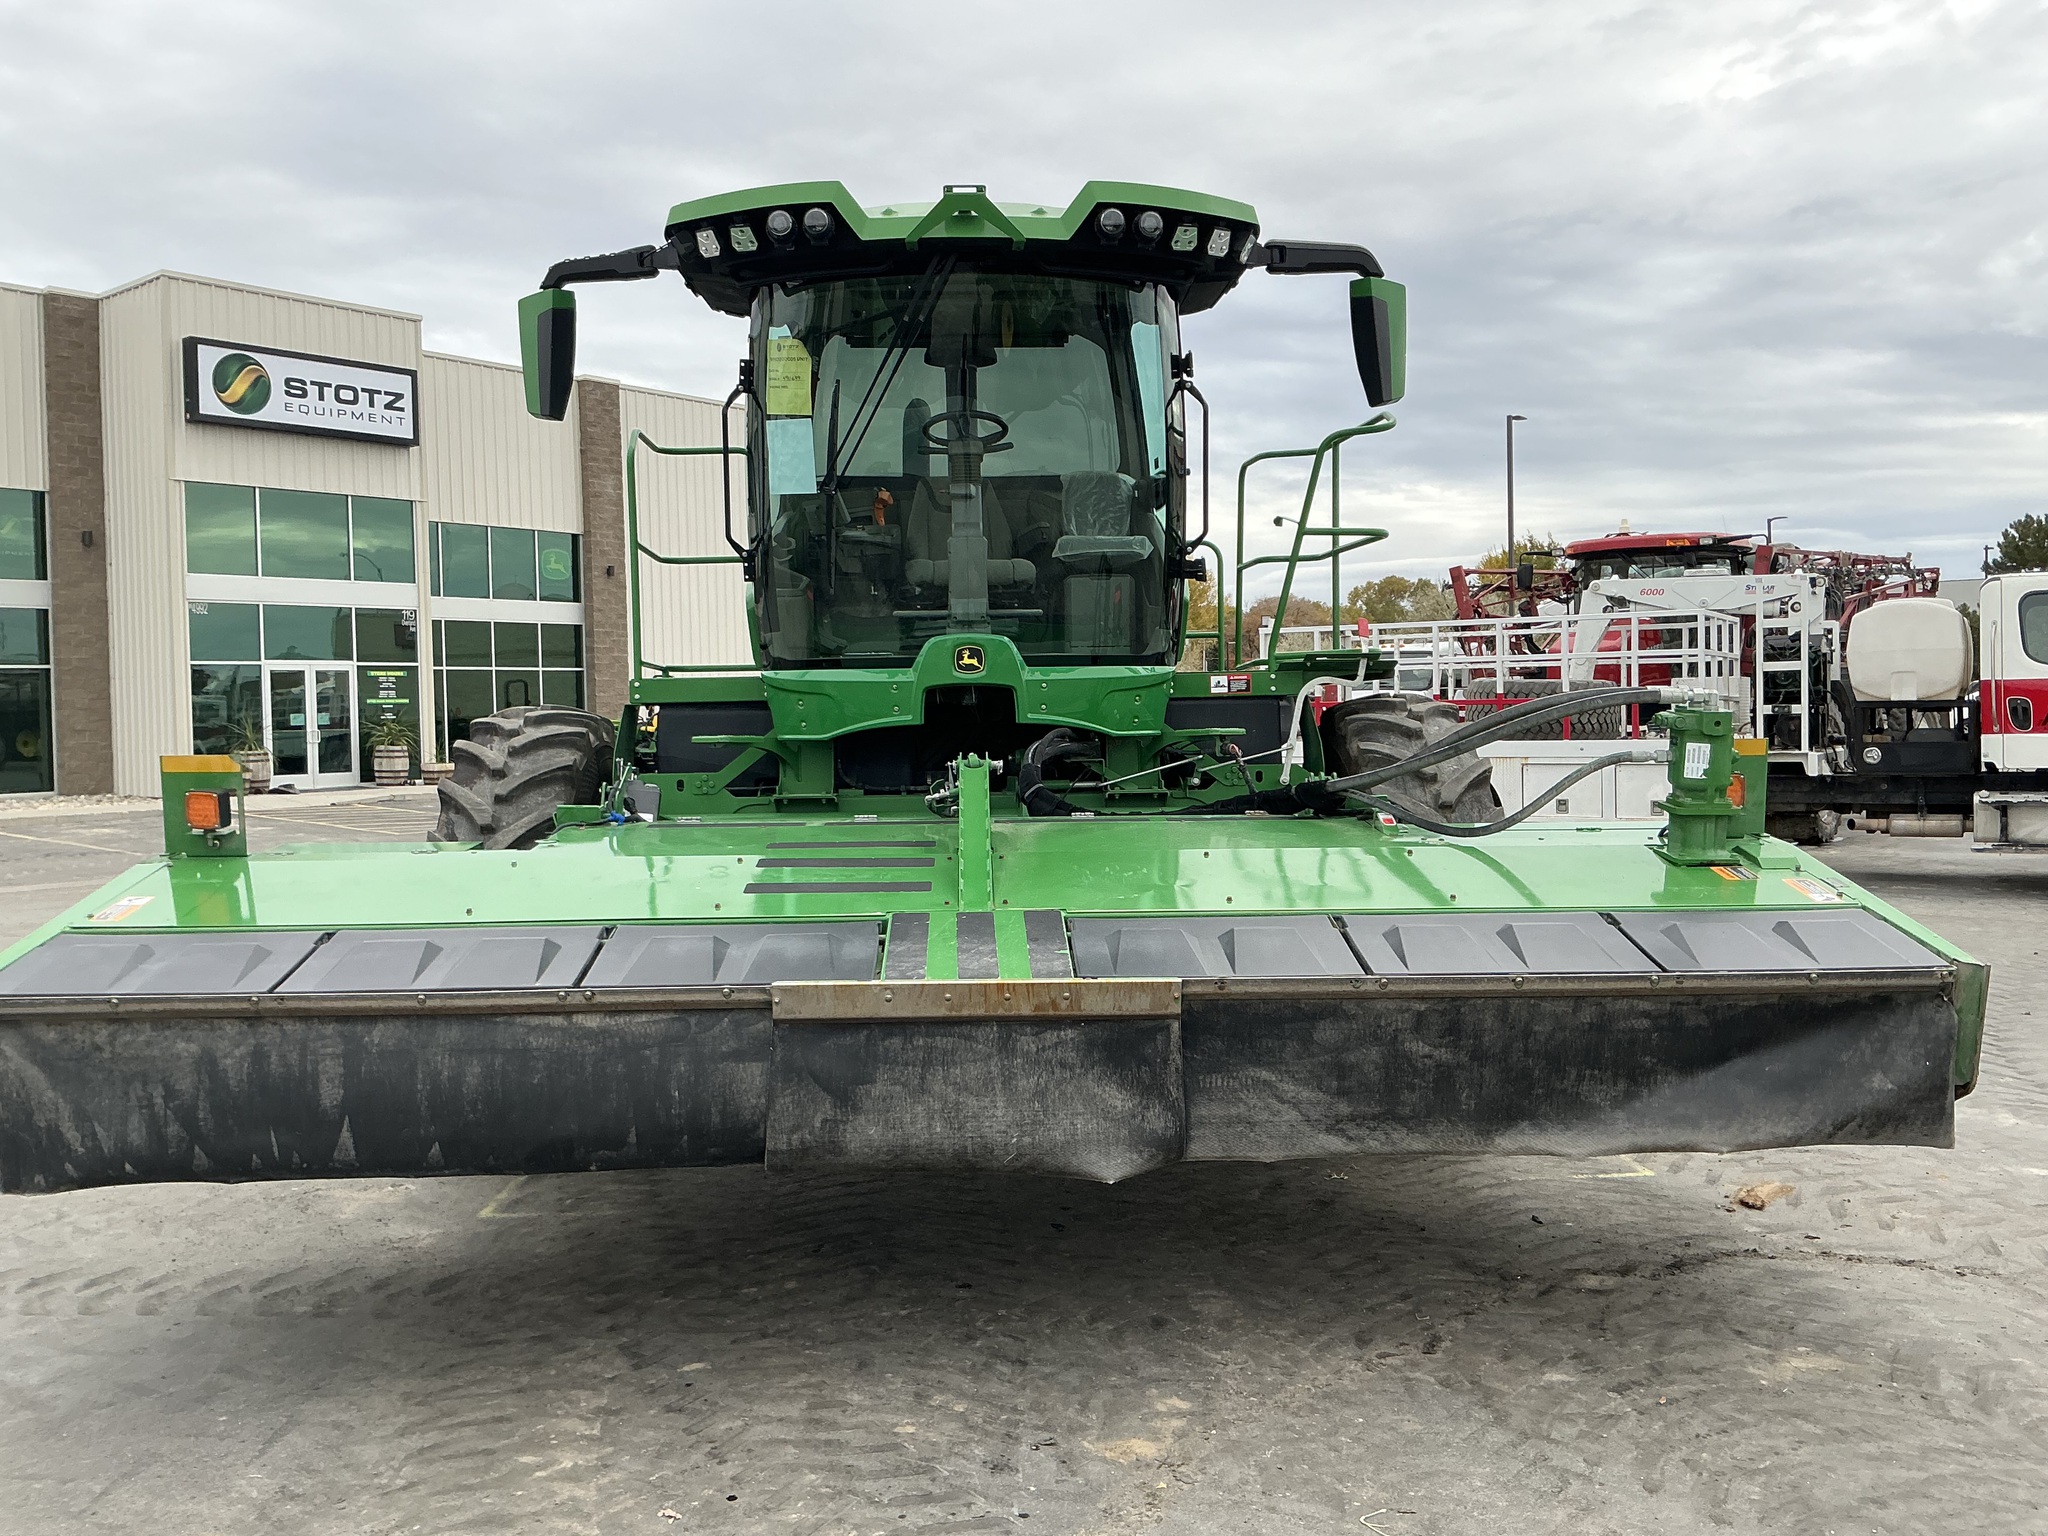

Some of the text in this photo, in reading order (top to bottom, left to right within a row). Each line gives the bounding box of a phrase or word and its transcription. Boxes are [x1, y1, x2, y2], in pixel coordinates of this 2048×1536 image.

[284, 377, 405, 413] STOTZ
[285, 402, 406, 426] EQUIPMENT
[1640, 588, 1665, 596] 6000
[402, 609, 415, 620] 119
